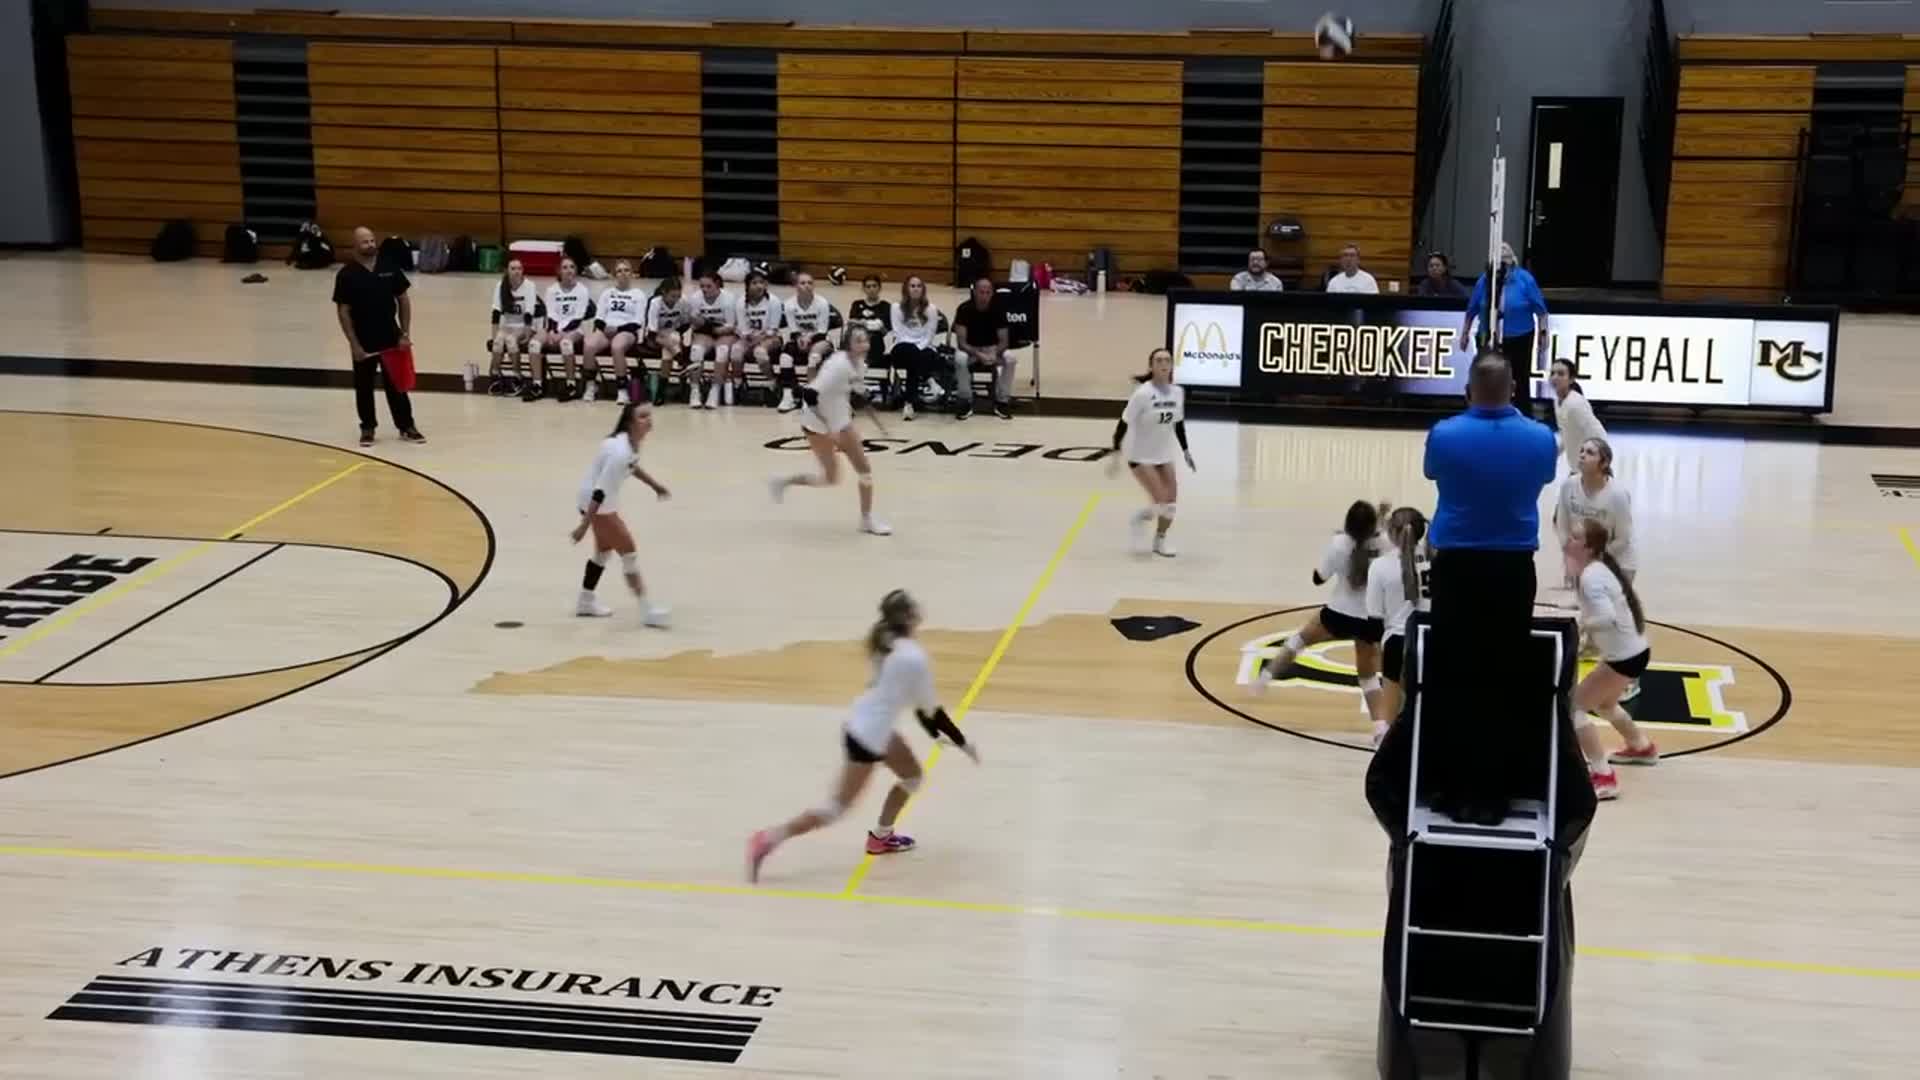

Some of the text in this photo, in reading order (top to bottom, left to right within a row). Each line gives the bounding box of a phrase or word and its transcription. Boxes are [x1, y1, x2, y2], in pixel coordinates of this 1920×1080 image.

[610, 301, 626, 312] 32
[1259, 322, 1724, 384] CHEROKEE LEYBALL
[1759, 339, 1824, 382] MC
[0, 553, 158, 634] RIBE
[115, 946, 782, 1008] ATHENS INSURANCE
